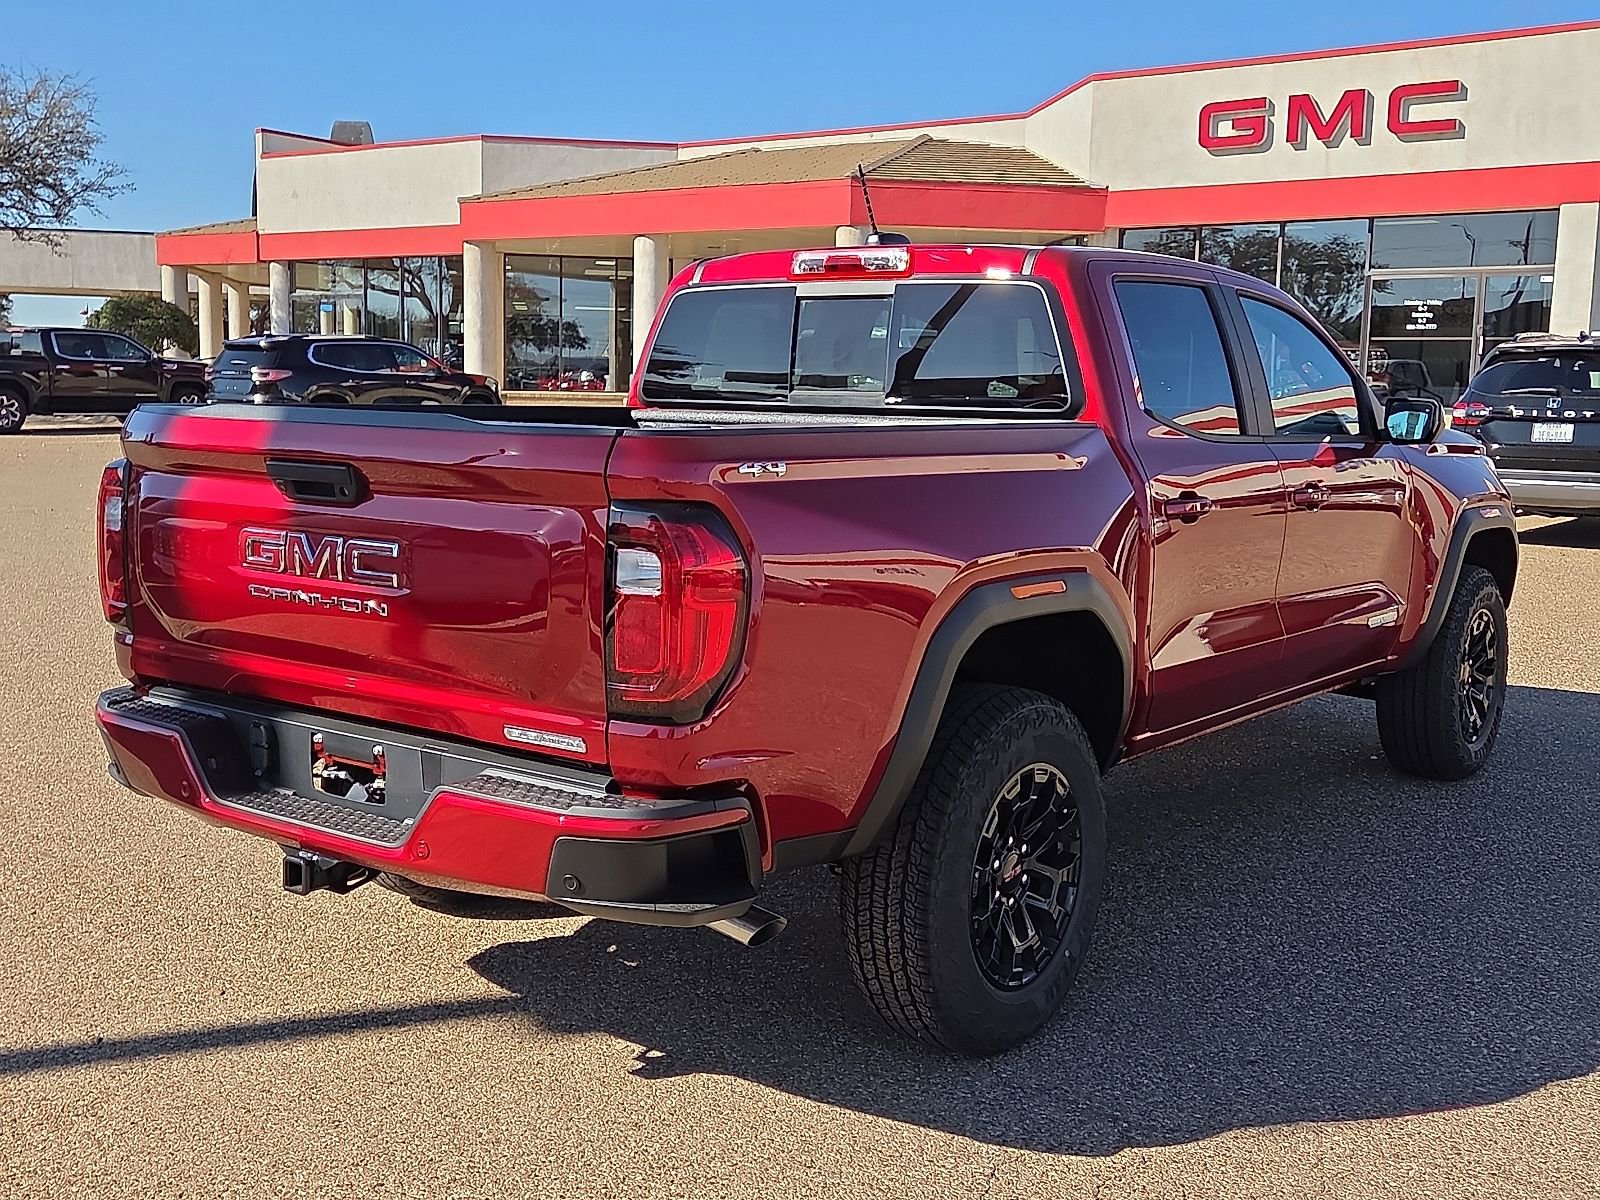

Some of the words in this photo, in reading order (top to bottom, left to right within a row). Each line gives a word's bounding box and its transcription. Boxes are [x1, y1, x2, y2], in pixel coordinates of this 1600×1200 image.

[1199, 80, 1466, 155] GMC
[1512, 409, 1595, 419] PILOT
[238, 527, 399, 588] GMC
[248, 584, 388, 616] CANYON
